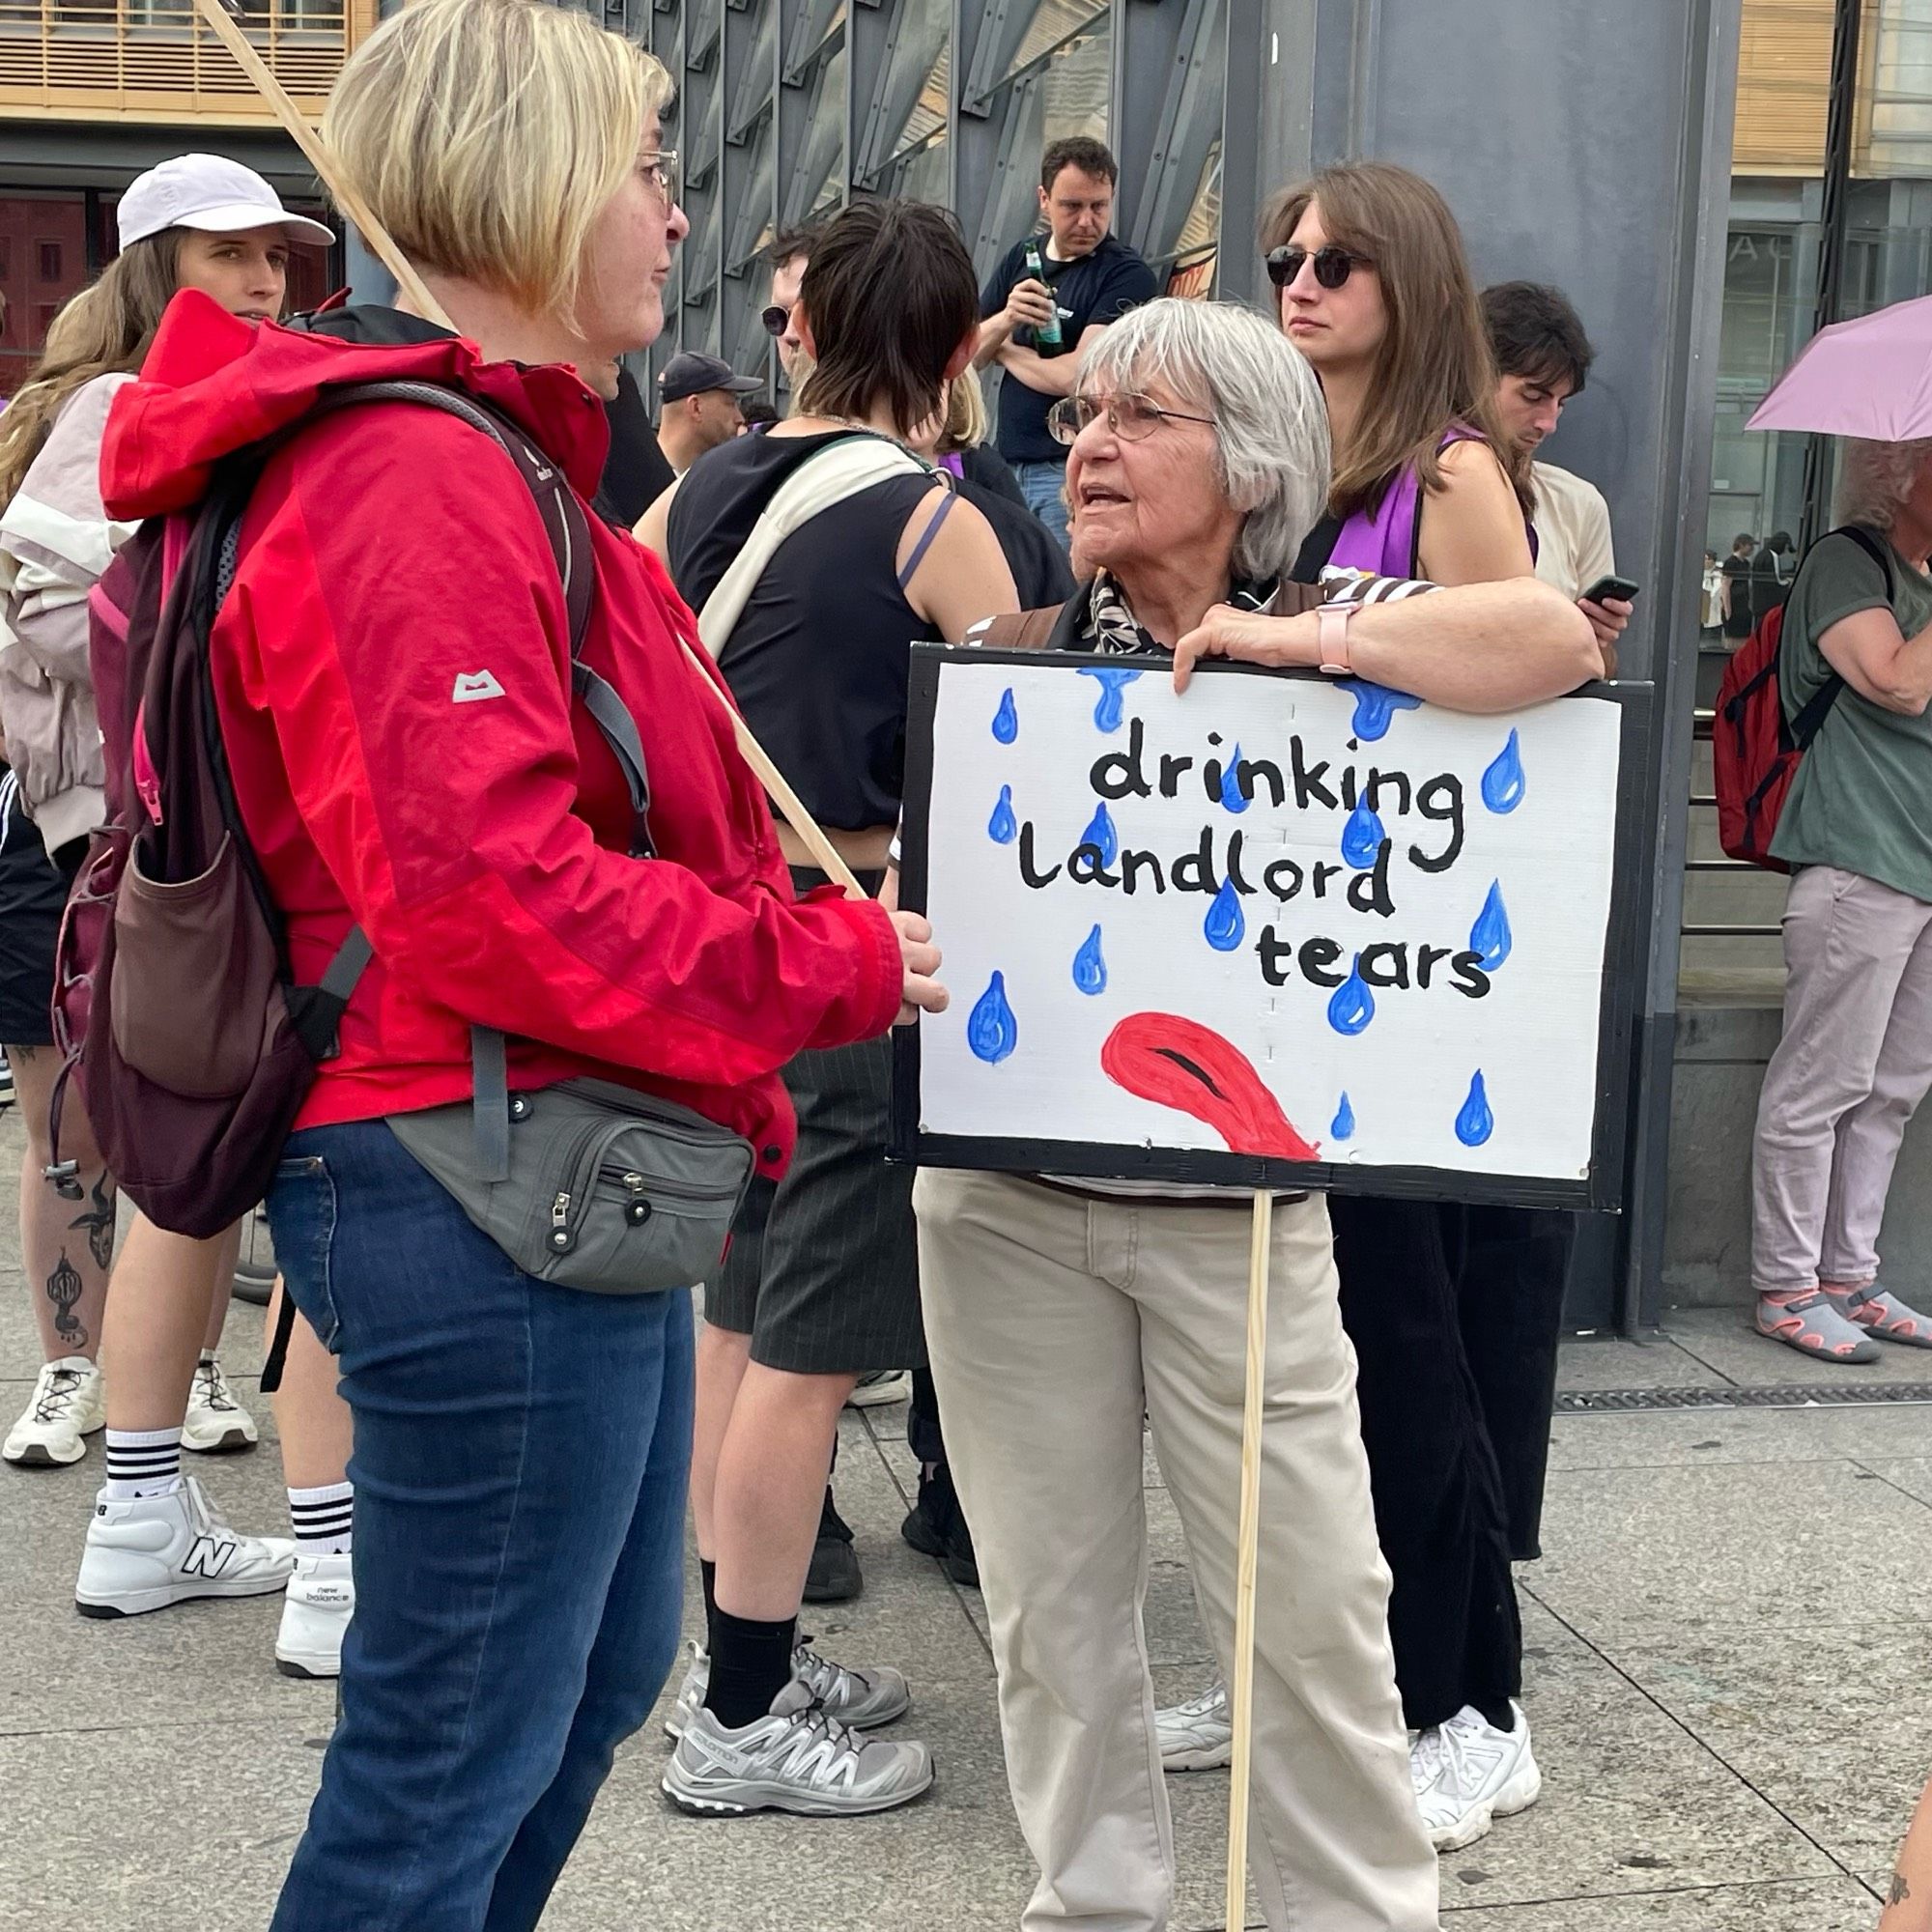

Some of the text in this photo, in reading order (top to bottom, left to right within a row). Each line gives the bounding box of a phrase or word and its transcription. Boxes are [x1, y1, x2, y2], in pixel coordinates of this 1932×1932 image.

[1091, 718, 1464, 873] drinking
[1019, 821, 1396, 918] landlord
[1255, 924, 1492, 999] tears
[181, 1536, 237, 1578] N
[306, 1592, 350, 1602] balance
